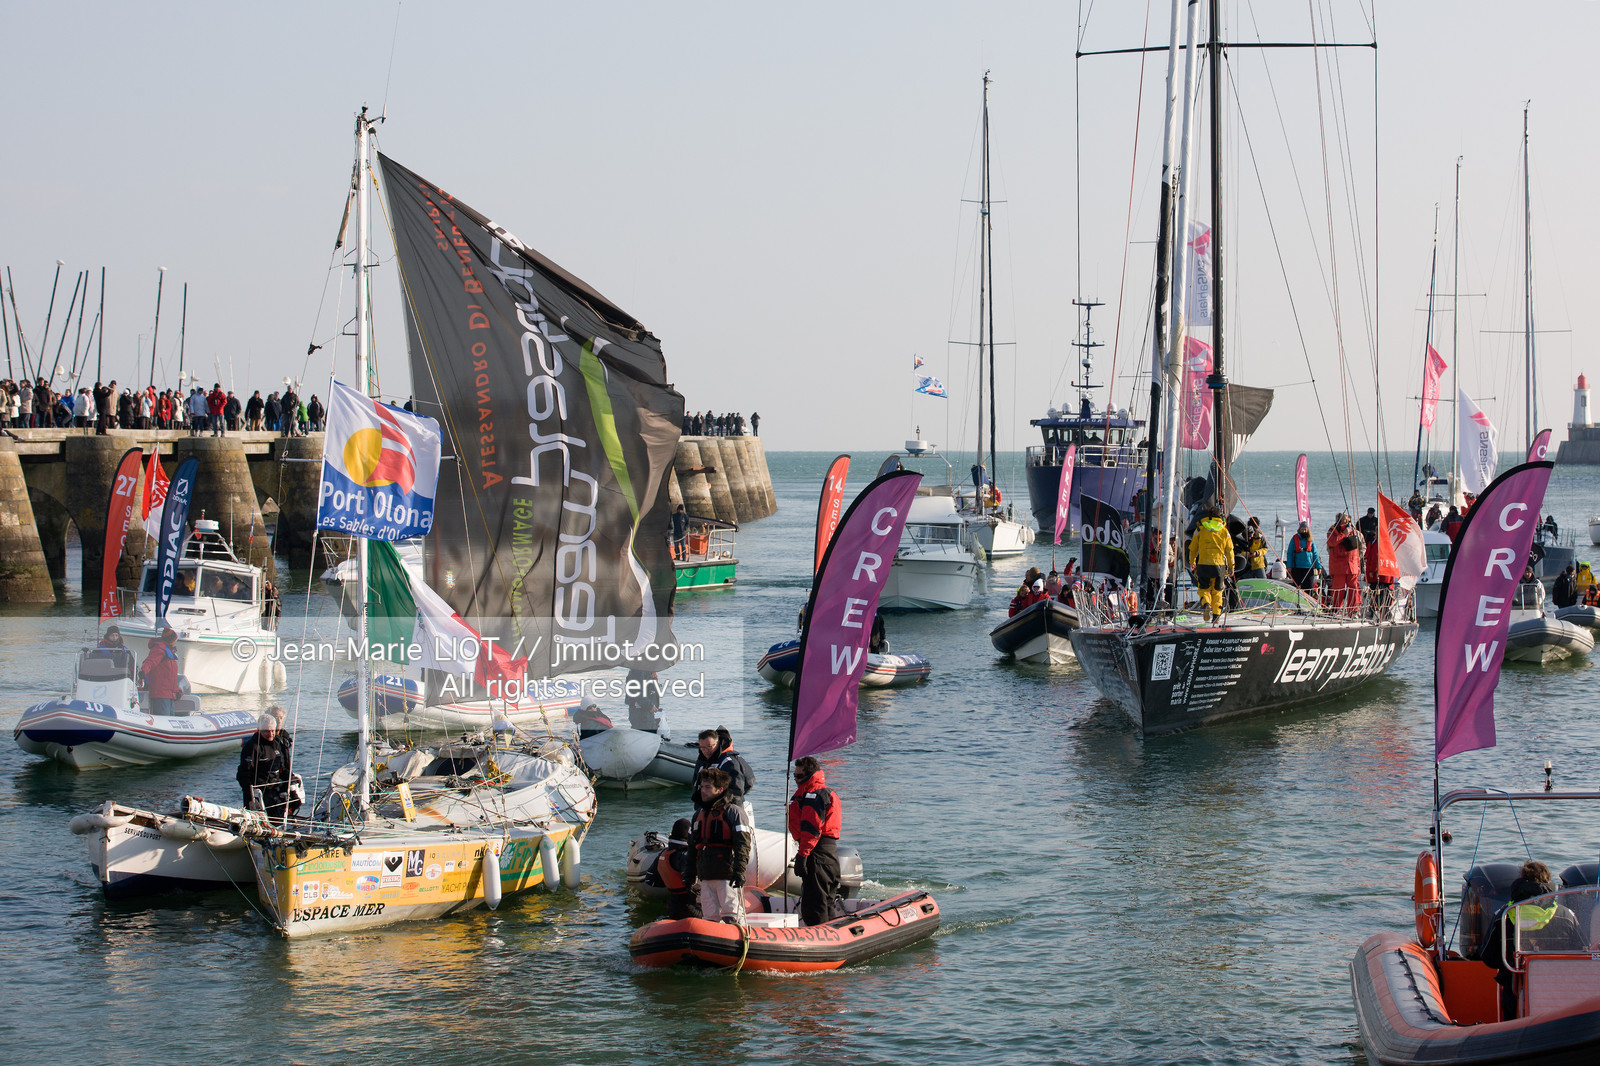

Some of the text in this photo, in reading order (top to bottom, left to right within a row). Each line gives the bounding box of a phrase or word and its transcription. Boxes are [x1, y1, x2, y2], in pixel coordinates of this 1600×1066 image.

[116, 474, 137, 497] 27
[829, 475, 843, 493] 14
[320, 481, 432, 528] Port Olona
[339, 516, 375, 536] Sables
[830, 507, 897, 676] CREW
[1464, 502, 1527, 674] CREW
[1273, 629, 1340, 684] Team
[386, 675, 403, 687] 21
[84, 701, 104, 713] 10
[293, 903, 386, 923] ESPACE MER
